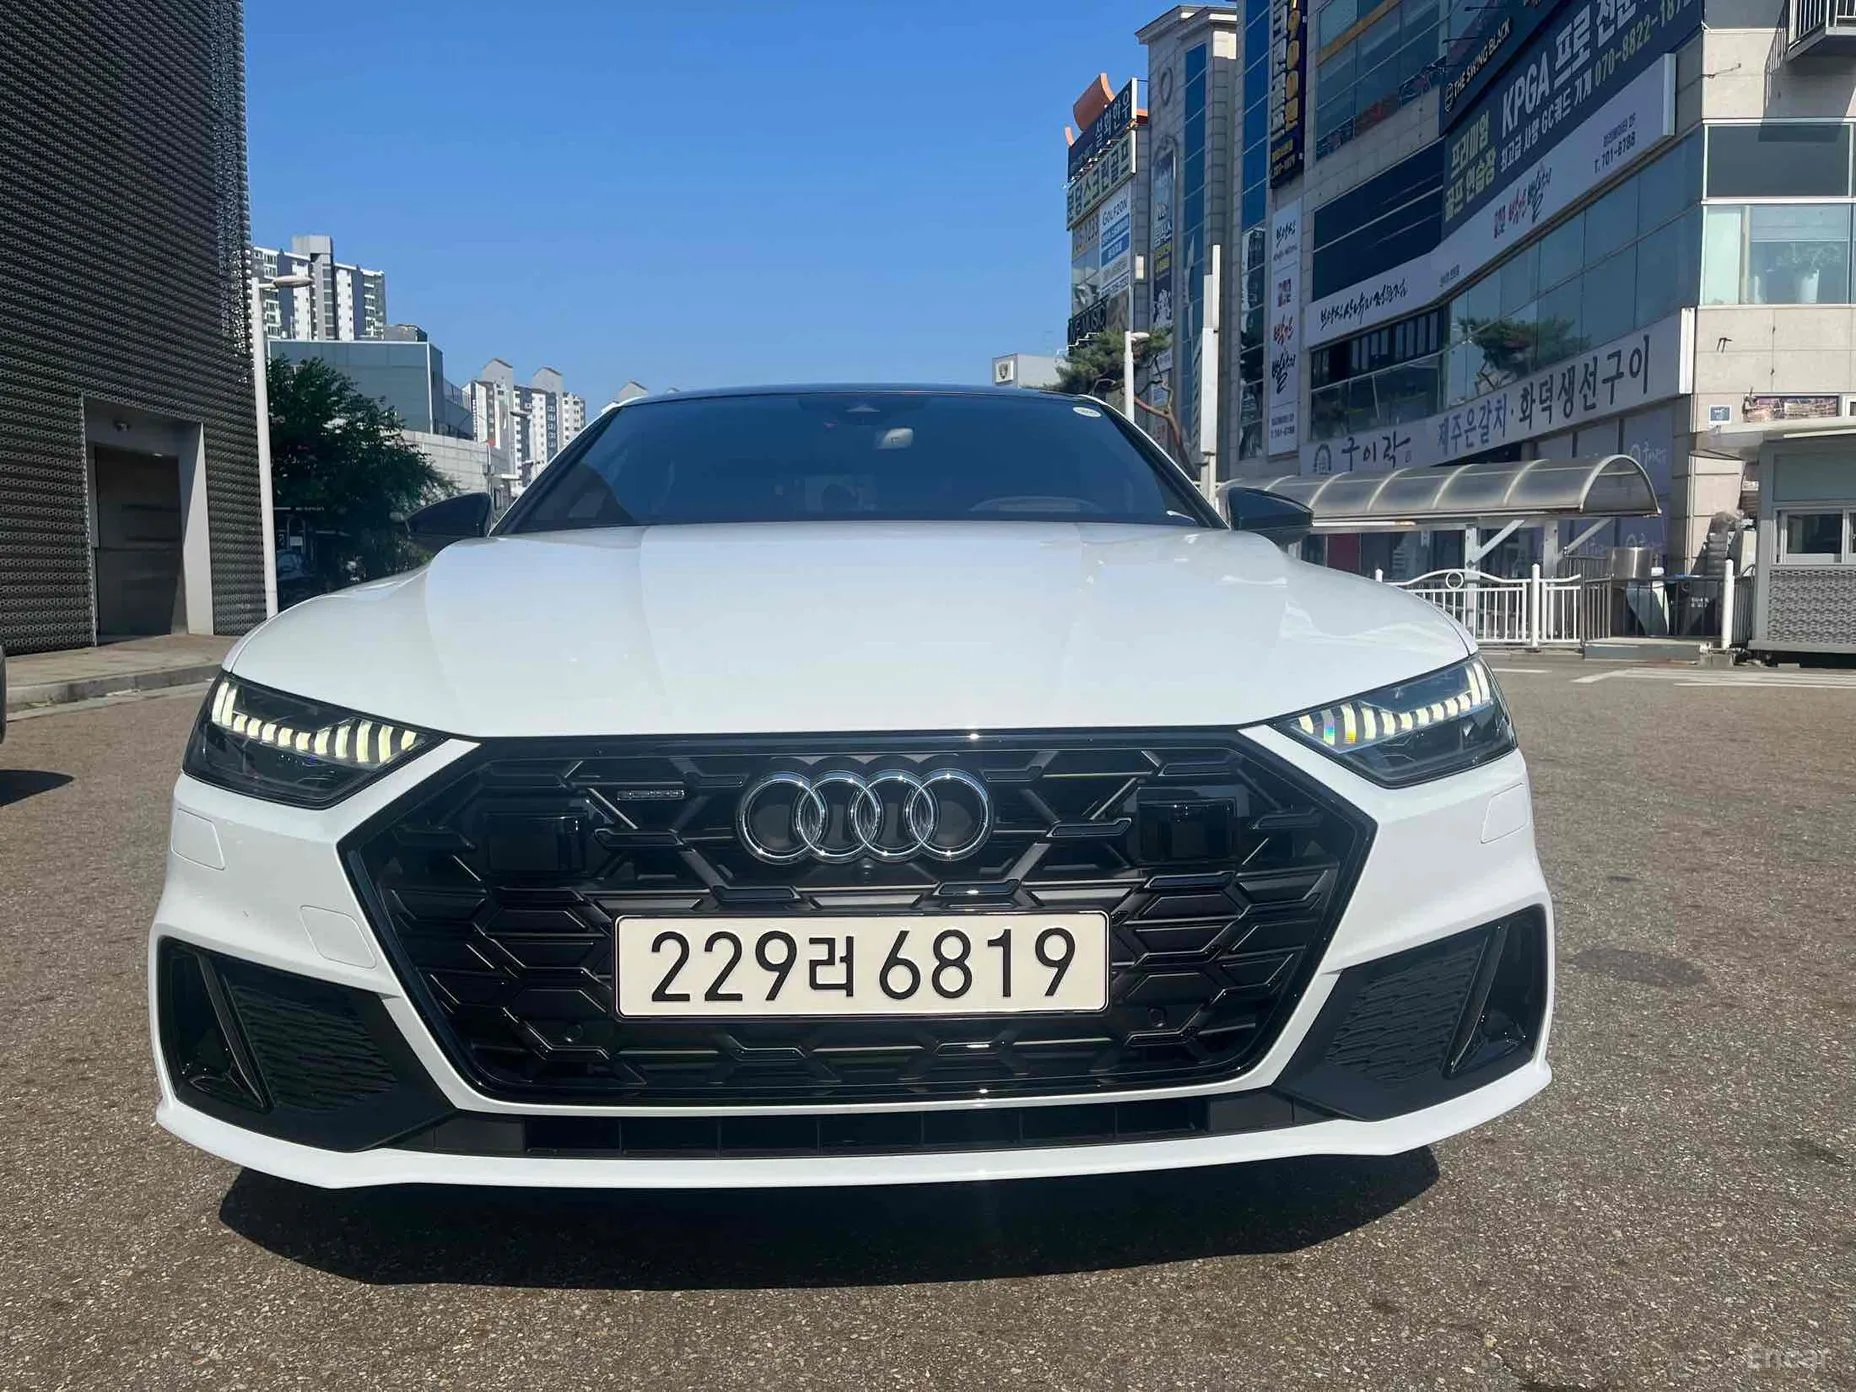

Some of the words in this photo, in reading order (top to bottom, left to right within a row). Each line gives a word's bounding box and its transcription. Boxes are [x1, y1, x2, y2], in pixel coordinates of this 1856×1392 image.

[1453, 71, 1466, 98] THE
[1502, 51, 1550, 139] KPGA
[1553, 5, 1591, 90] 프로
[1450, 110, 1490, 179] 프리미엄
[1500, 137, 1522, 173] 최고급
[1523, 119, 1540, 153] 사양
[1445, 186, 1464, 223] 골프
[1465, 146, 1497, 202] 연습장
[1518, 334, 1651, 430] 화덕생선구이
[1341, 431, 1411, 472] 구이락
[650, 930, 855, 1002] 229러
[878, 927, 1077, 1000] 6819
